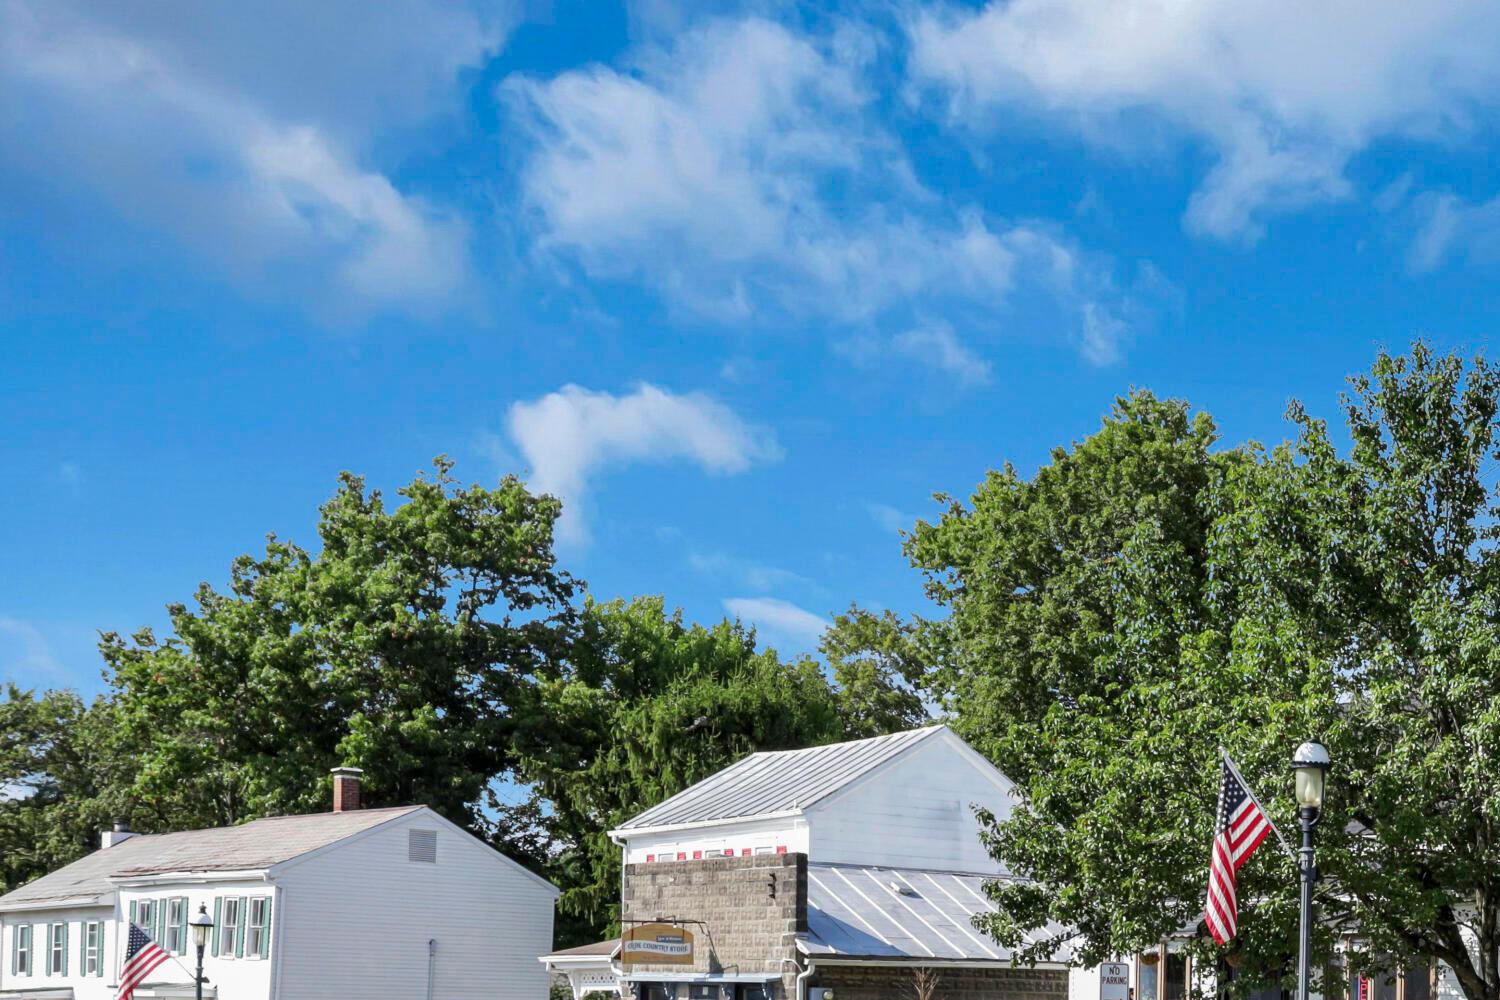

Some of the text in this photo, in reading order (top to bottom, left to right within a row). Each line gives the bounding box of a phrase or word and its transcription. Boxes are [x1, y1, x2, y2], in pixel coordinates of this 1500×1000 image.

[643, 943, 669, 952] COUNTRY
[670, 945, 688, 953] STORE
[1109, 966, 1120, 975] NO
